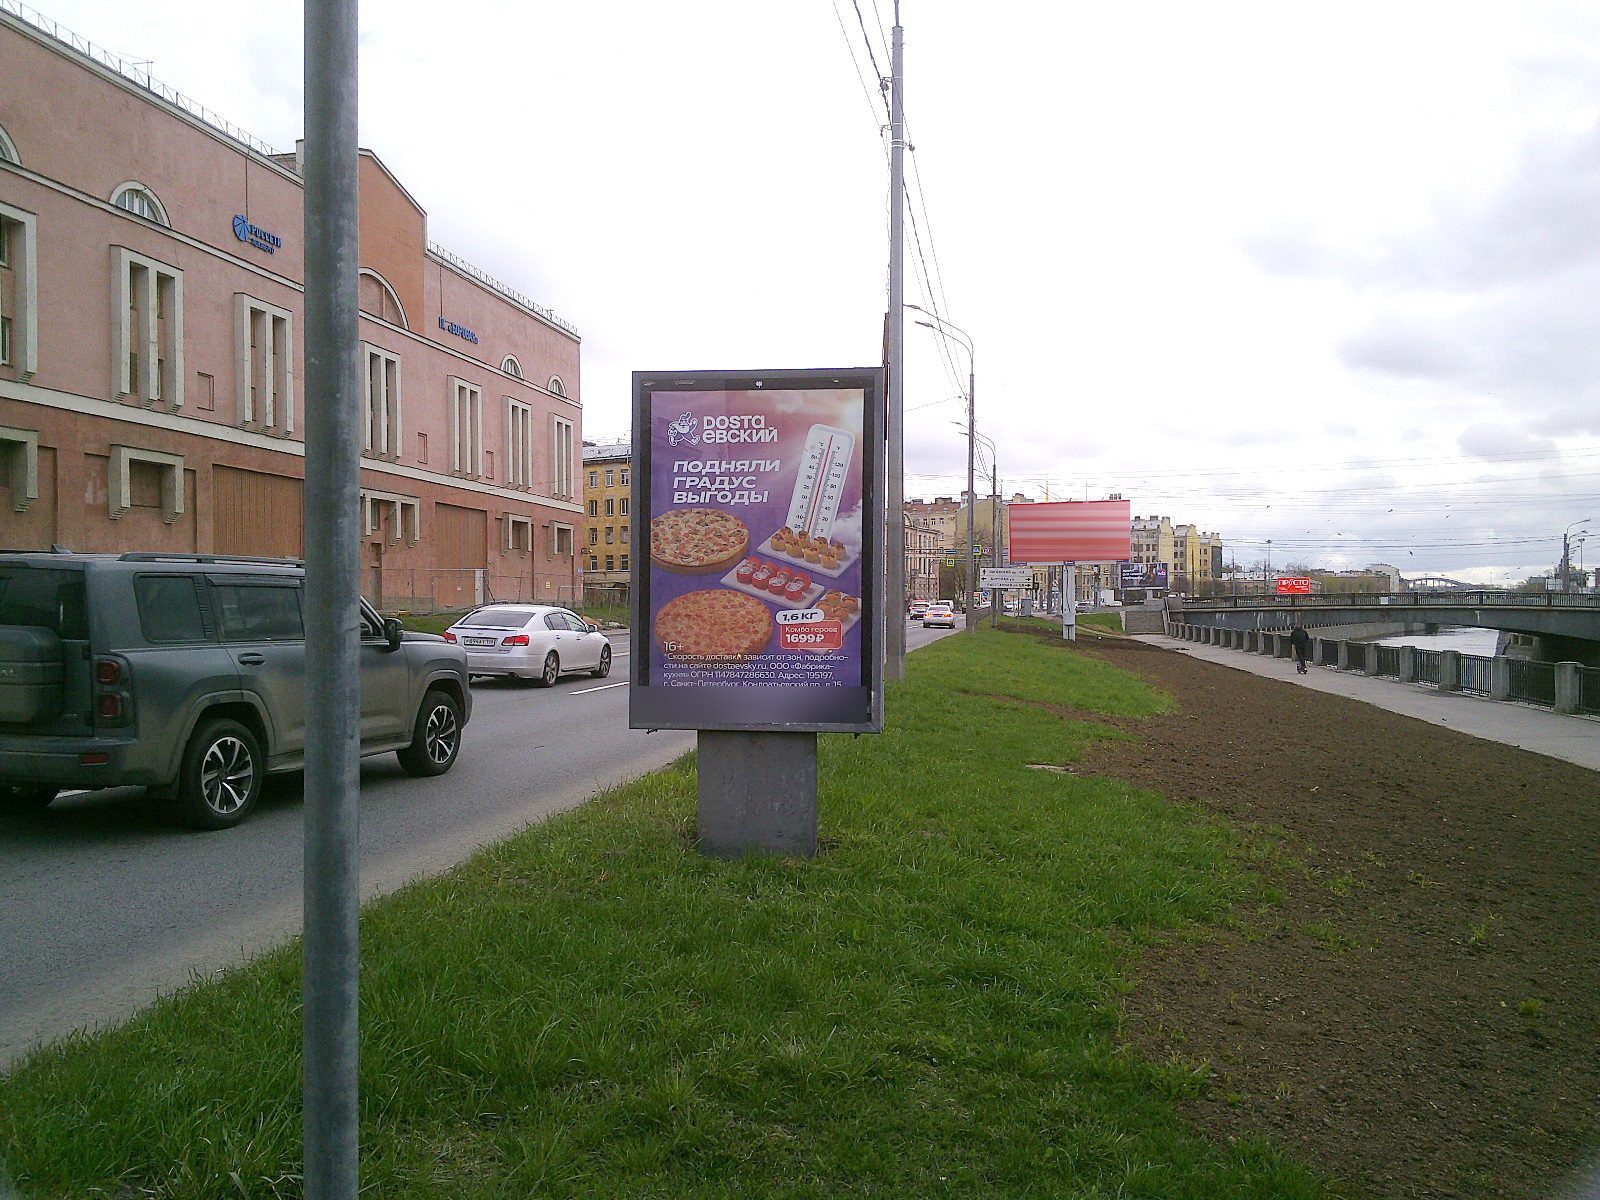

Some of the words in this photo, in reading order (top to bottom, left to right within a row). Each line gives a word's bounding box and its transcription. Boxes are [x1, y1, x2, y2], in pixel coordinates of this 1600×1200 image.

[672, 459, 781, 475] ПОДНЯЛИ
[672, 476, 757, 491] ГРАДУС
[672, 490, 769, 506] ВЫГОДЫ
[782, 613, 799, 622] 1,6
[801, 612, 818, 620] КГ
[785, 625, 810, 633] Комбо
[663, 641, 684, 651] 16+
[689, 662, 712, 670] сайте
[769, 662, 790, 670] ООО
[690, 671, 714, 679] ОГРН
